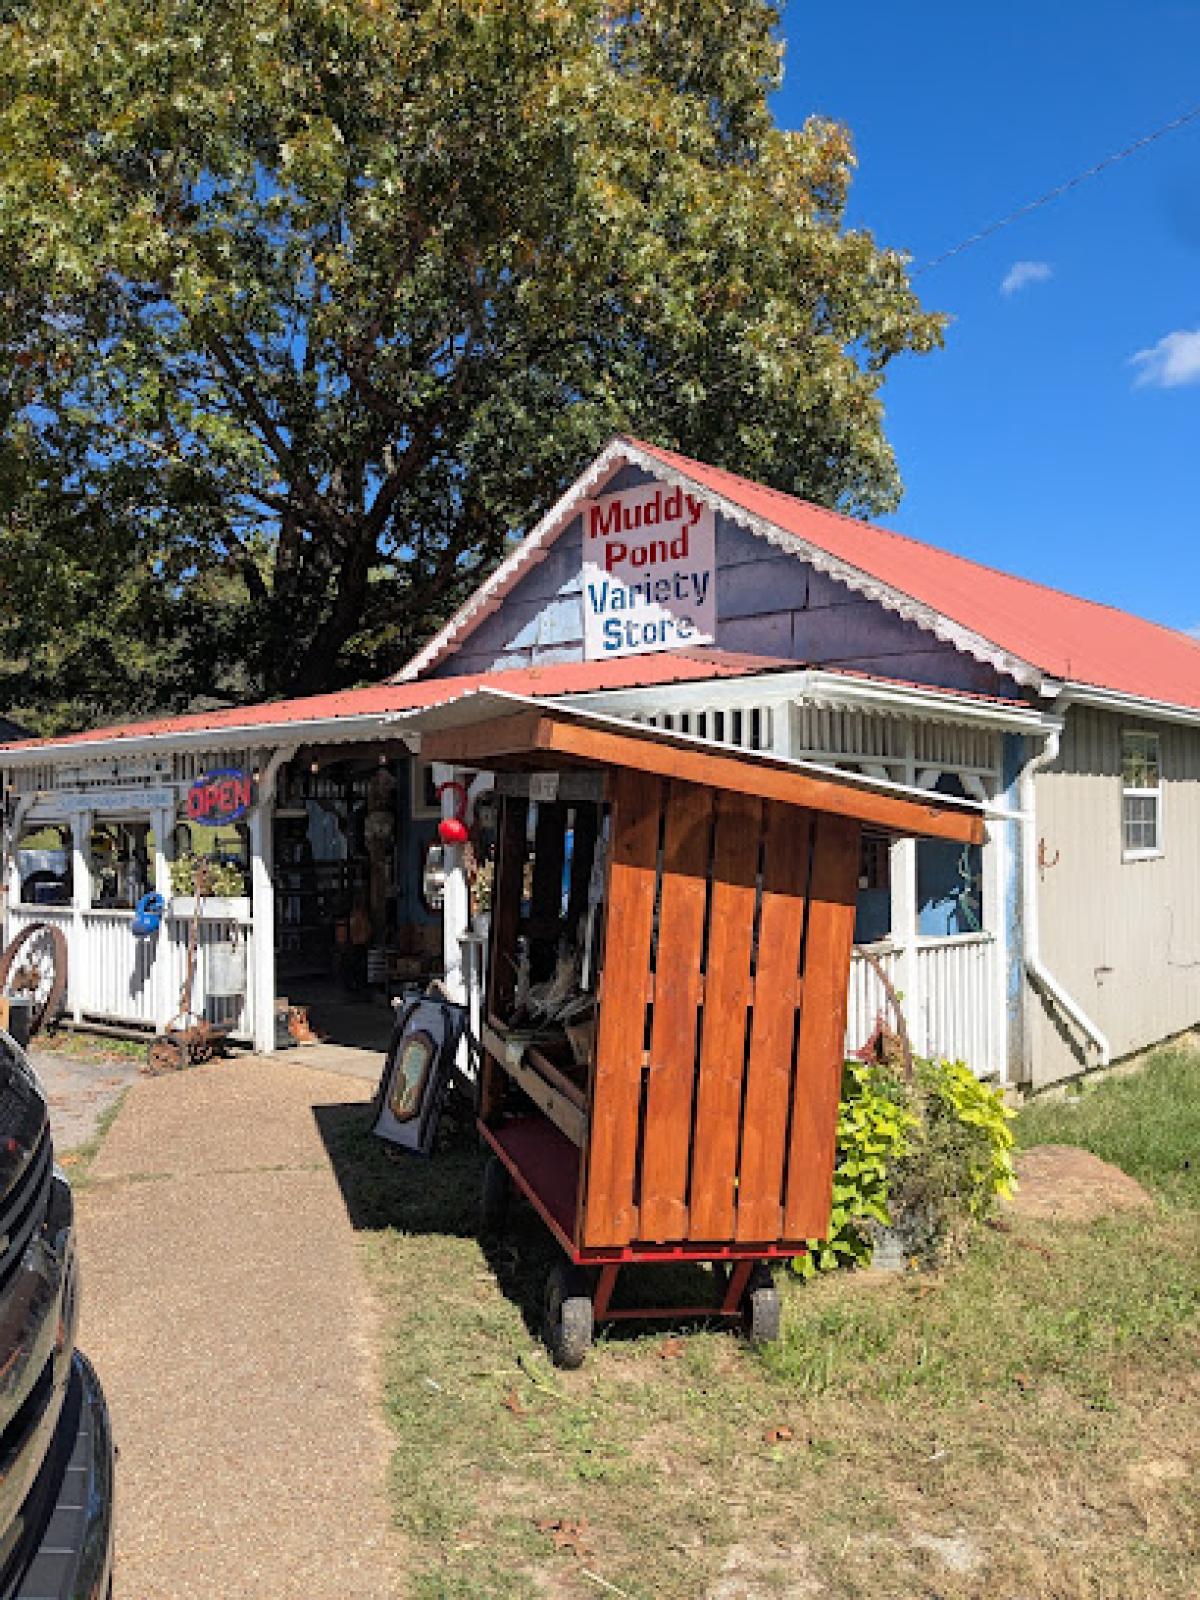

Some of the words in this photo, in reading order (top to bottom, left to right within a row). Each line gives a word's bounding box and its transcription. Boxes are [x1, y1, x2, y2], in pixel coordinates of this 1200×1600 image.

[590, 485, 703, 539] Muddy
[605, 526, 689, 571] Pond
[588, 571, 709, 615] Variety
[602, 615, 694, 650] Store
[188, 776, 251, 817] OPEN
